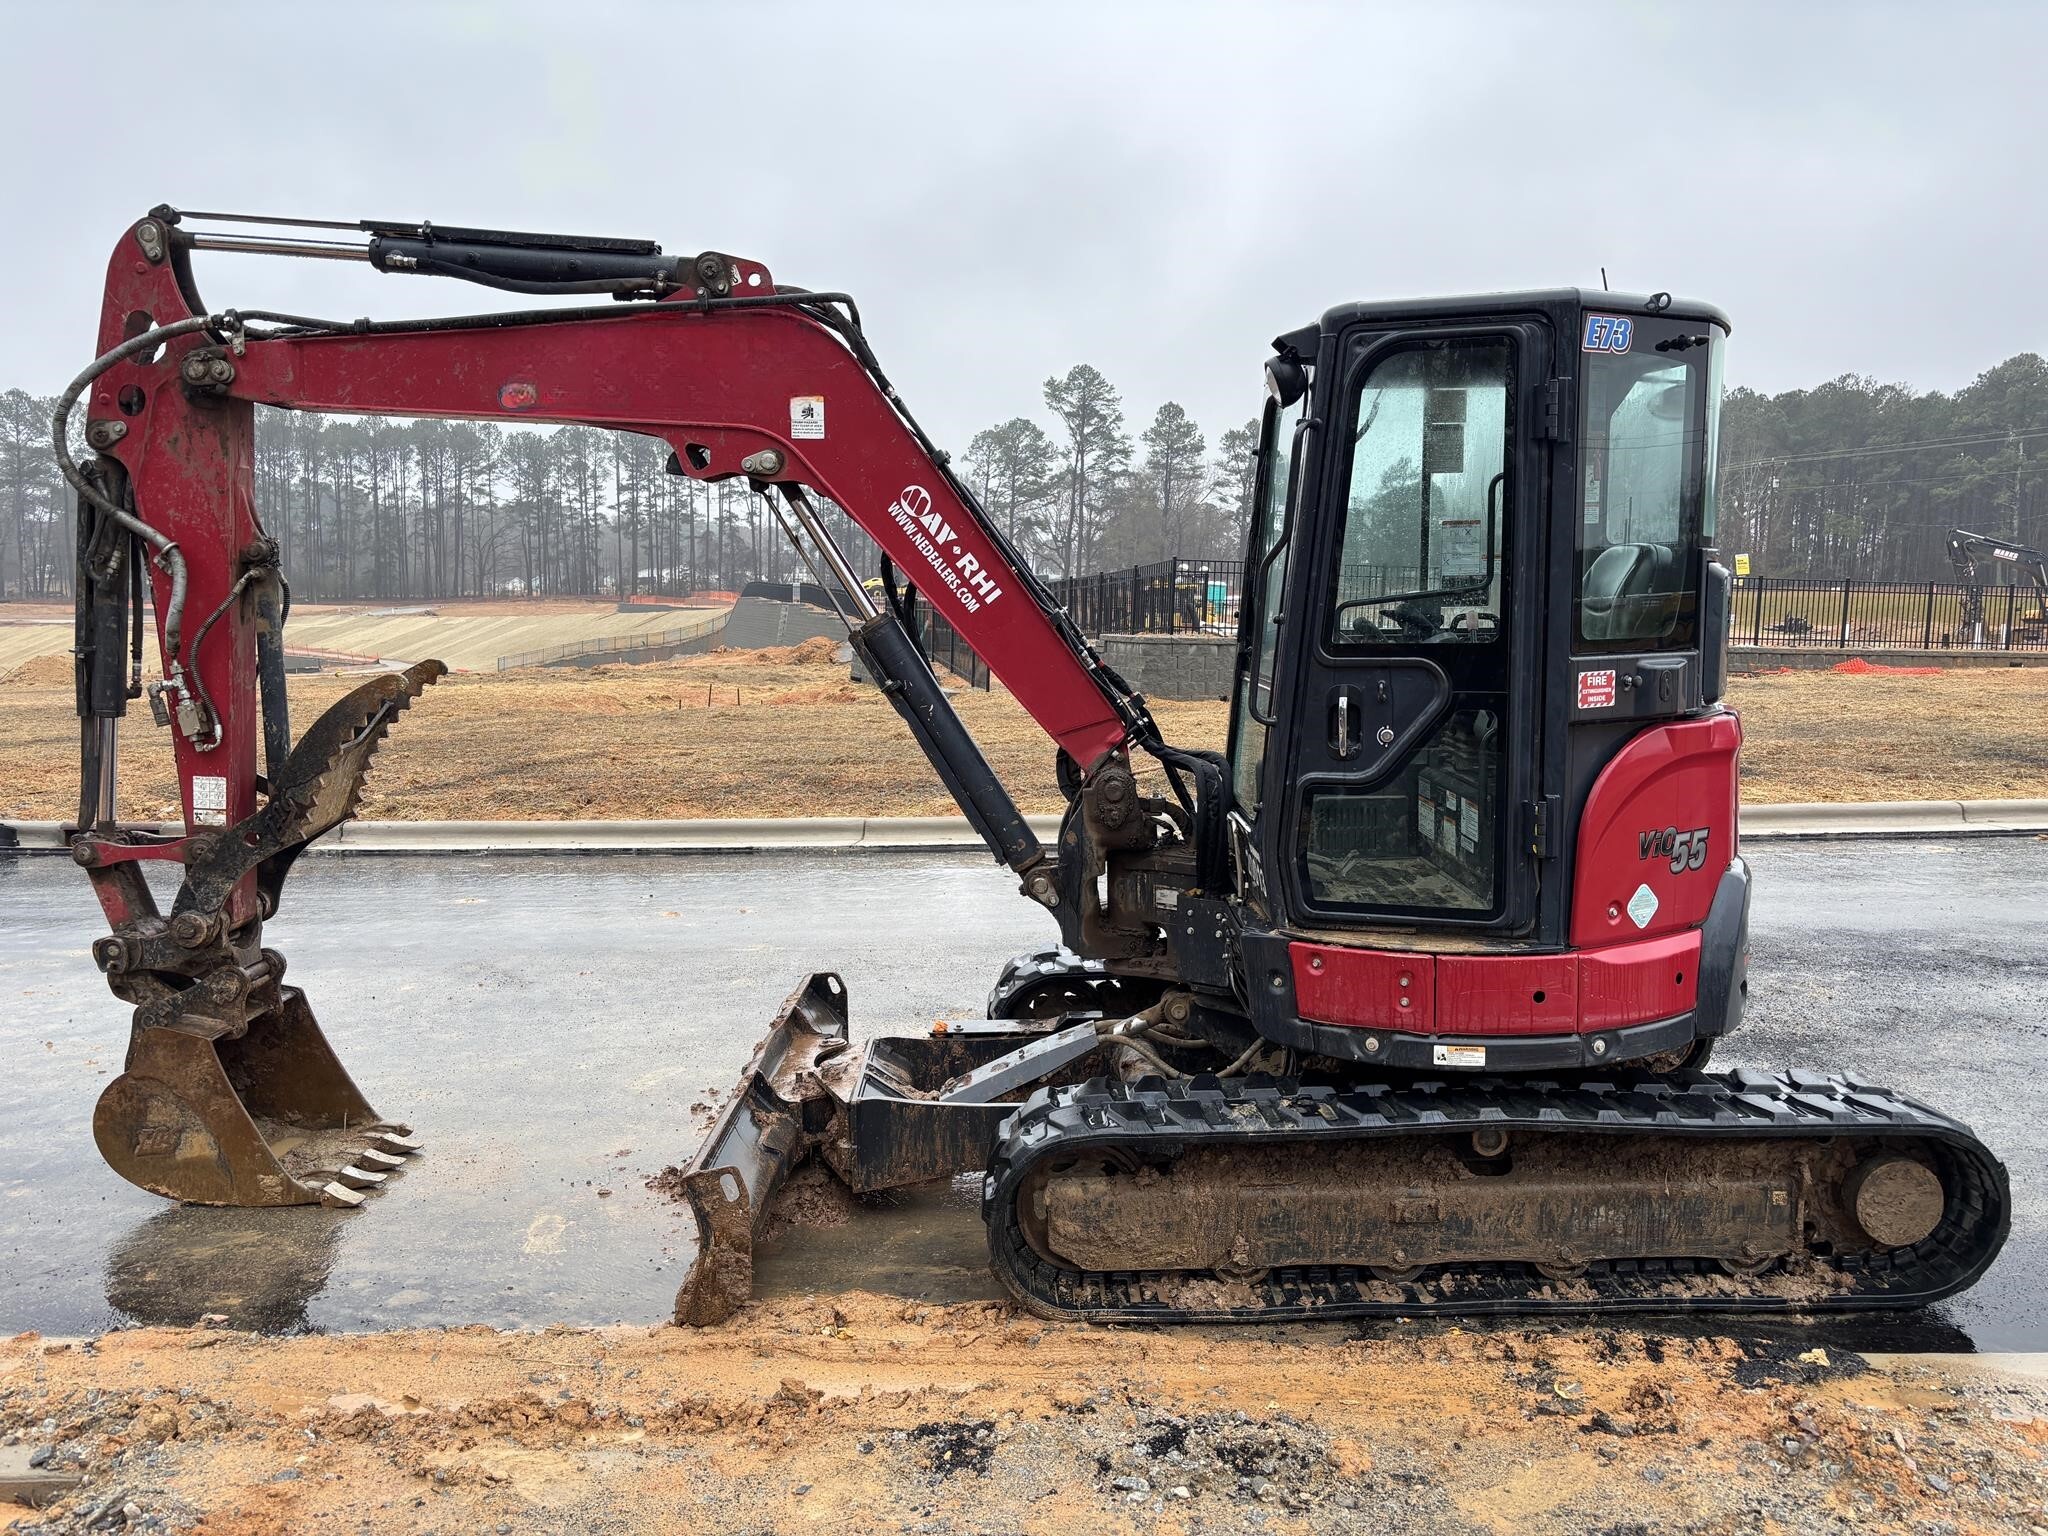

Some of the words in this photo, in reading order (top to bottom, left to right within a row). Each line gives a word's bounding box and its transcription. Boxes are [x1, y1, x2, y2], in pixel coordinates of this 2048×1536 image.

[1583, 314, 1633, 352] E73
[887, 500, 981, 614] WWW.NEDEALERS.COM
[1587, 675, 1608, 687] FIRE
[1587, 694, 1606, 703] INSIDE
